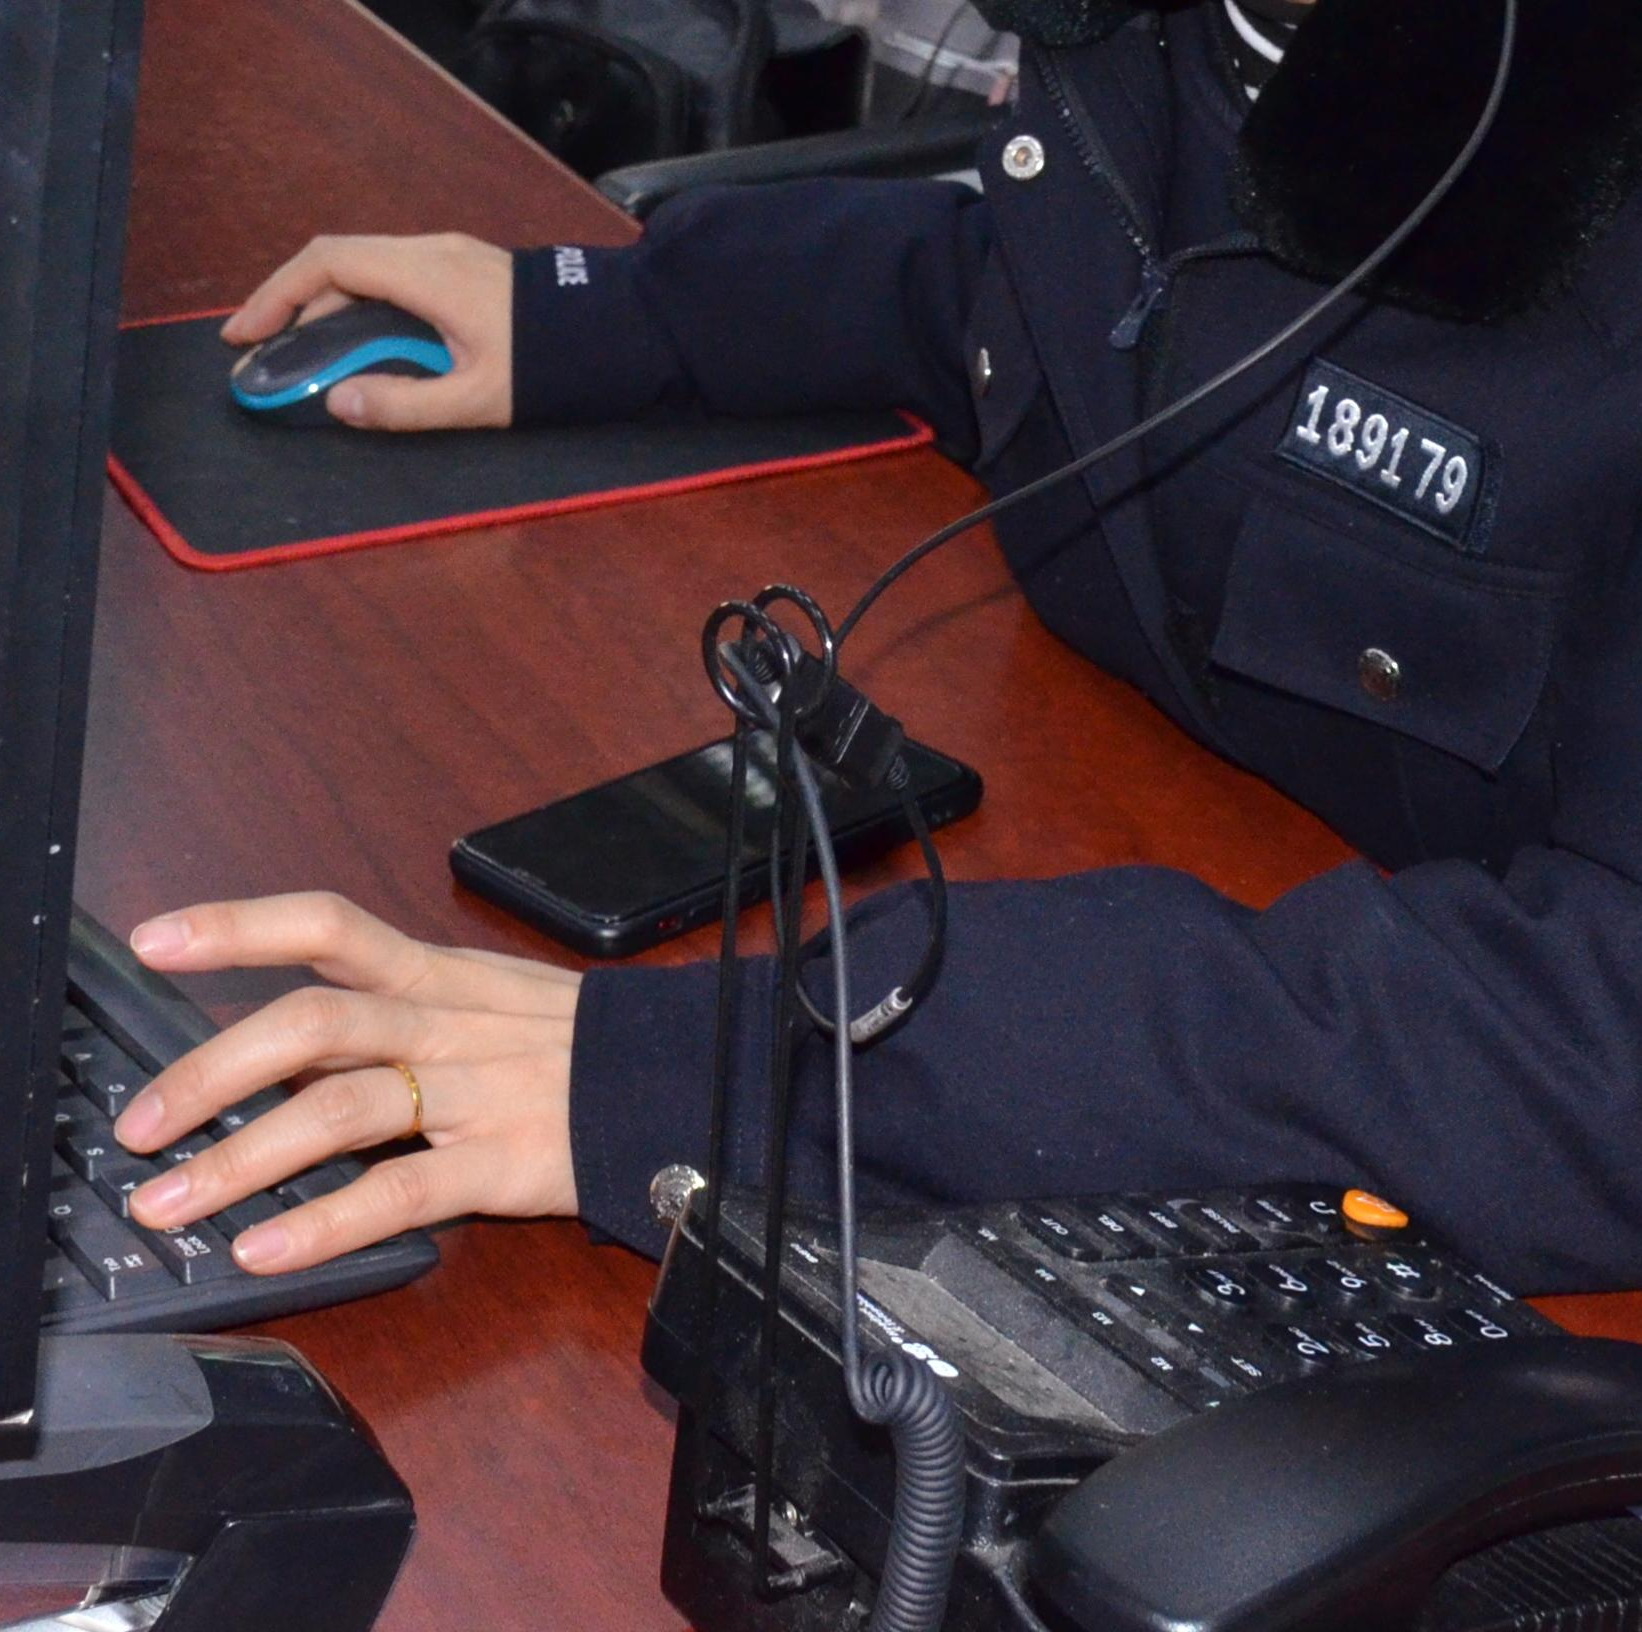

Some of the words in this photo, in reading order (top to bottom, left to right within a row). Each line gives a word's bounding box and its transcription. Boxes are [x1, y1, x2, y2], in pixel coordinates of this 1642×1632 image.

[1297, 385, 1468, 515] 189179
[87, 1146, 104, 1157] S
[1041, 1217, 1069, 1236] OUT
[1098, 1214, 1124, 1233] DEL
[1217, 1282, 1246, 1296] 3
[1279, 1279, 1307, 1292] 6
[1340, 1276, 1367, 1289] 9
[1424, 1332, 1453, 1346] 8
[1480, 1325, 1508, 1339] 0
[1297, 1340, 1330, 1355] 2
[1358, 1333, 1391, 1348] 5
[1230, 1355, 1262, 1377] SET
